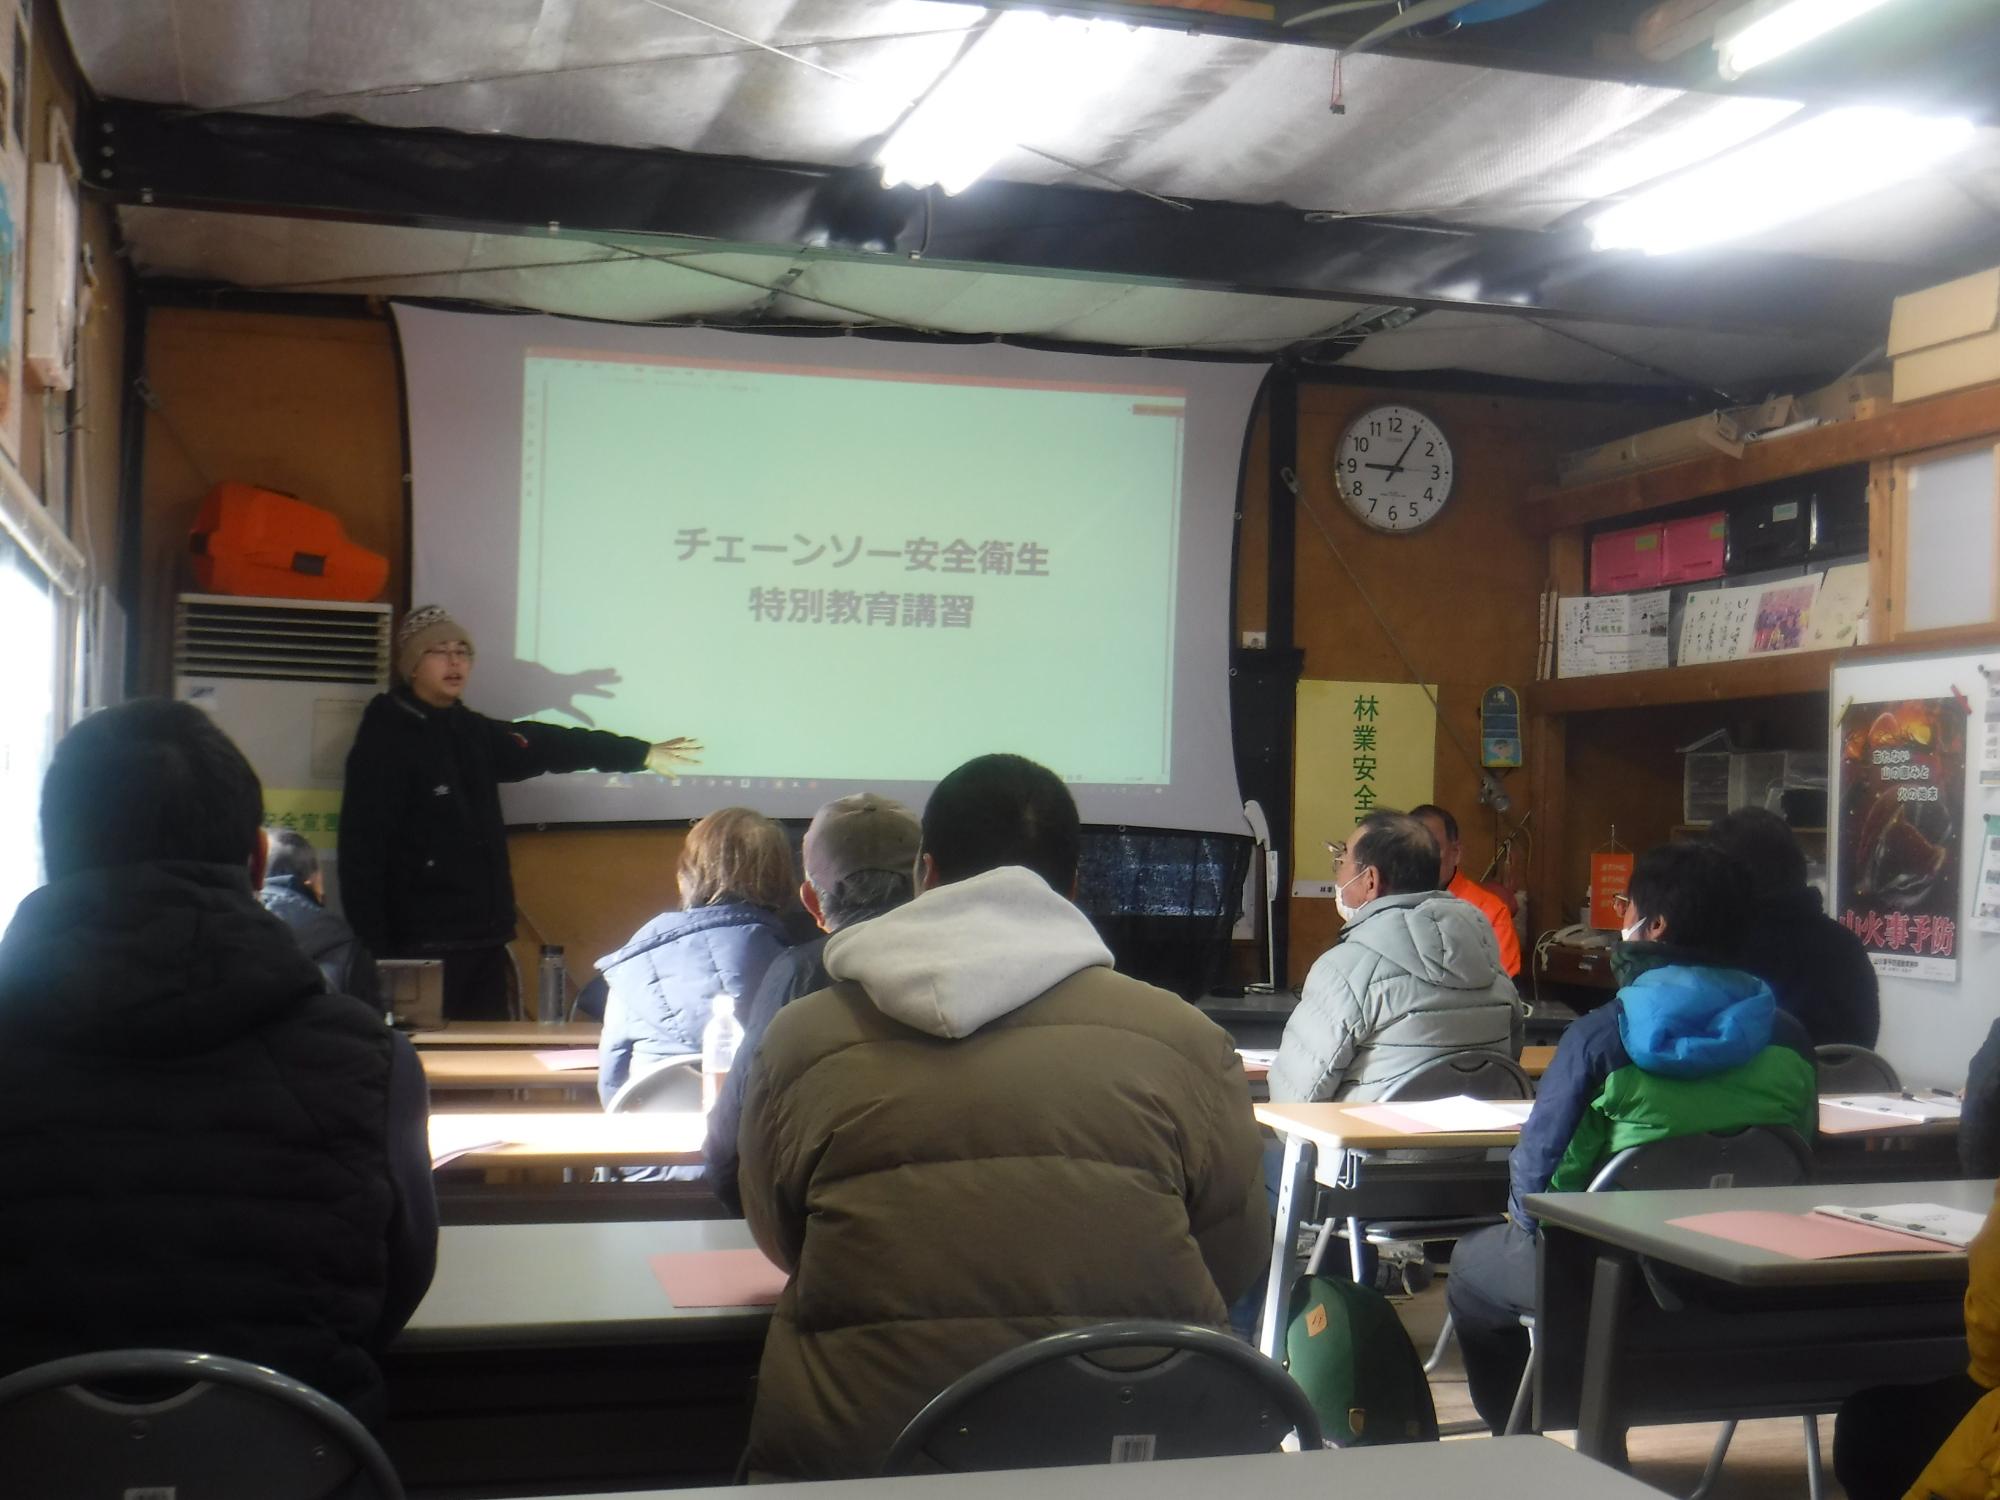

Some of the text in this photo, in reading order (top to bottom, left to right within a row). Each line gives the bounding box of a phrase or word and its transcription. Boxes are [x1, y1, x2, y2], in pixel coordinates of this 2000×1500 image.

[1370, 421, 1381, 437] 11
[1388, 417, 1403, 432] 12
[1353, 437, 1369, 452] 10
[1425, 441, 1435, 457] 2
[1347, 458, 1357, 473] 9
[1431, 465, 1440, 480] 3
[1352, 481, 1363, 496] 8
[1423, 487, 1433, 502] 4
[1368, 498, 1377, 513] 7
[1388, 505, 1397, 521] 6
[1409, 502, 1418, 517] 5
[674, 527, 1050, 577] チェーンソー安全衛生
[748, 586, 975, 629] 特別教育講習
[1352, 694, 1379, 825] 林業安全
